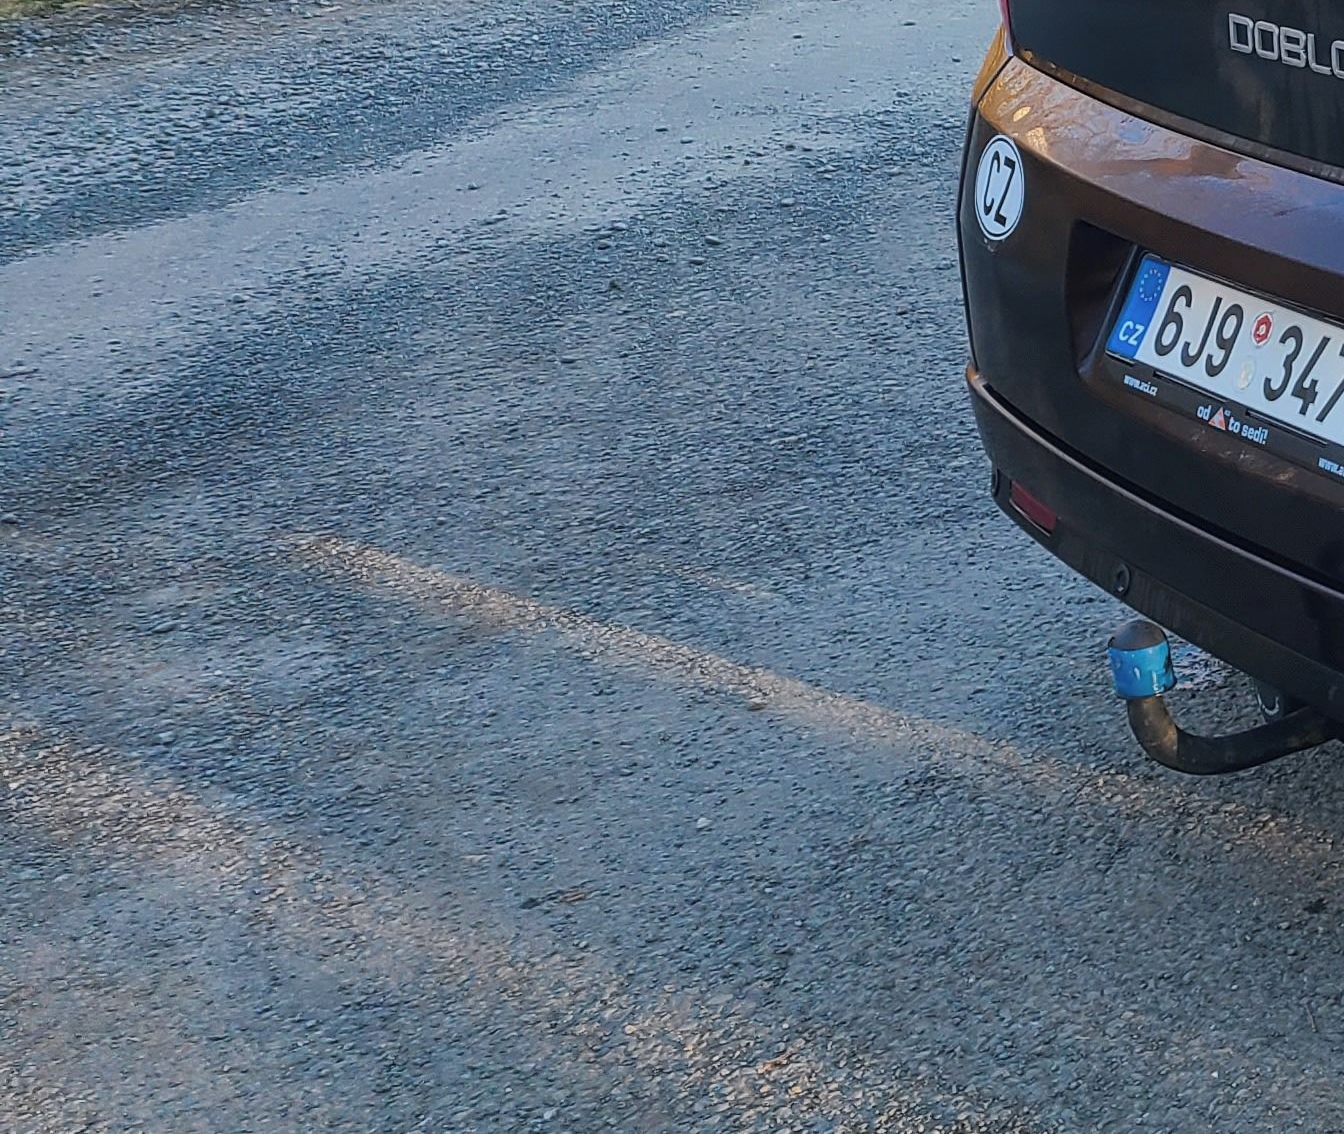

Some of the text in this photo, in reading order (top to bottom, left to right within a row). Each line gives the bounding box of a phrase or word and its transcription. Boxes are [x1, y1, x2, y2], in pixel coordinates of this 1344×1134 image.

[983, 150, 1016, 228] CZ
[1119, 321, 1145, 346] CZ
[1154, 285, 1244, 377] 6J9
[1196, 404, 1212, 421] od
[1228, 416, 1241, 434] to
